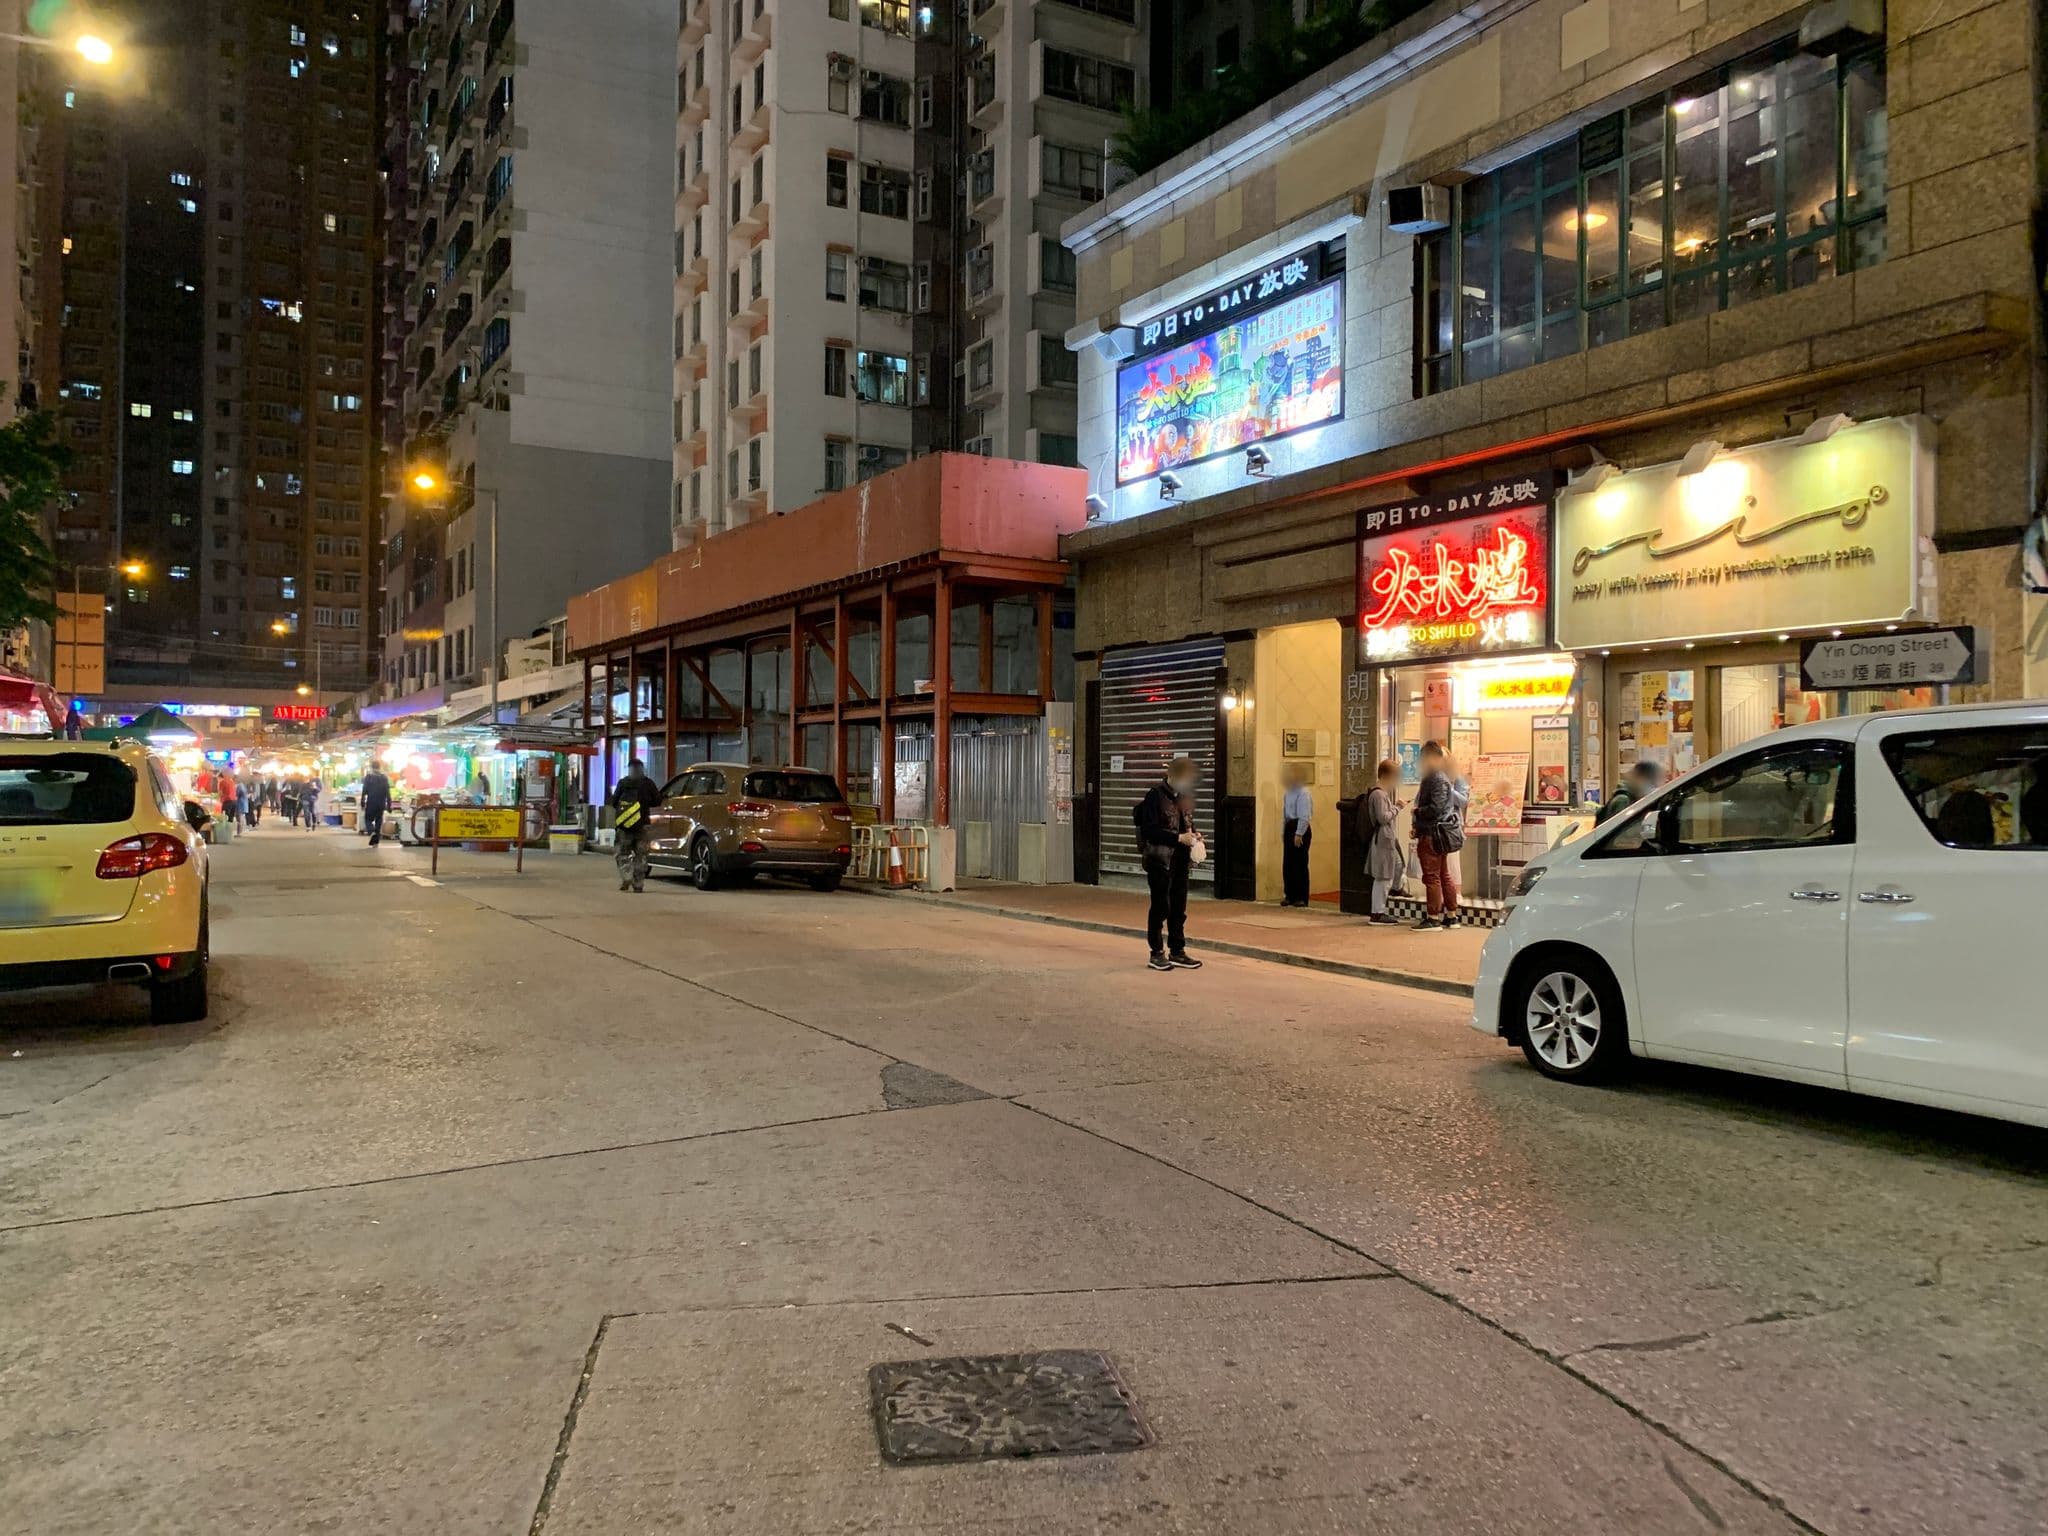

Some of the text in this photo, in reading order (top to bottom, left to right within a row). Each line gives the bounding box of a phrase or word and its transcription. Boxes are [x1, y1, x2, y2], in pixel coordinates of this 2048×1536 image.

[1835, 545, 1874, 561] coffee
[1411, 627, 1427, 641] FO
[1429, 624, 1457, 640] SHUI
[1460, 623, 1476, 637] LO
[1823, 636, 1949, 658] Yin Chong Street
[1344, 671, 1370, 771] 朗廷軒
